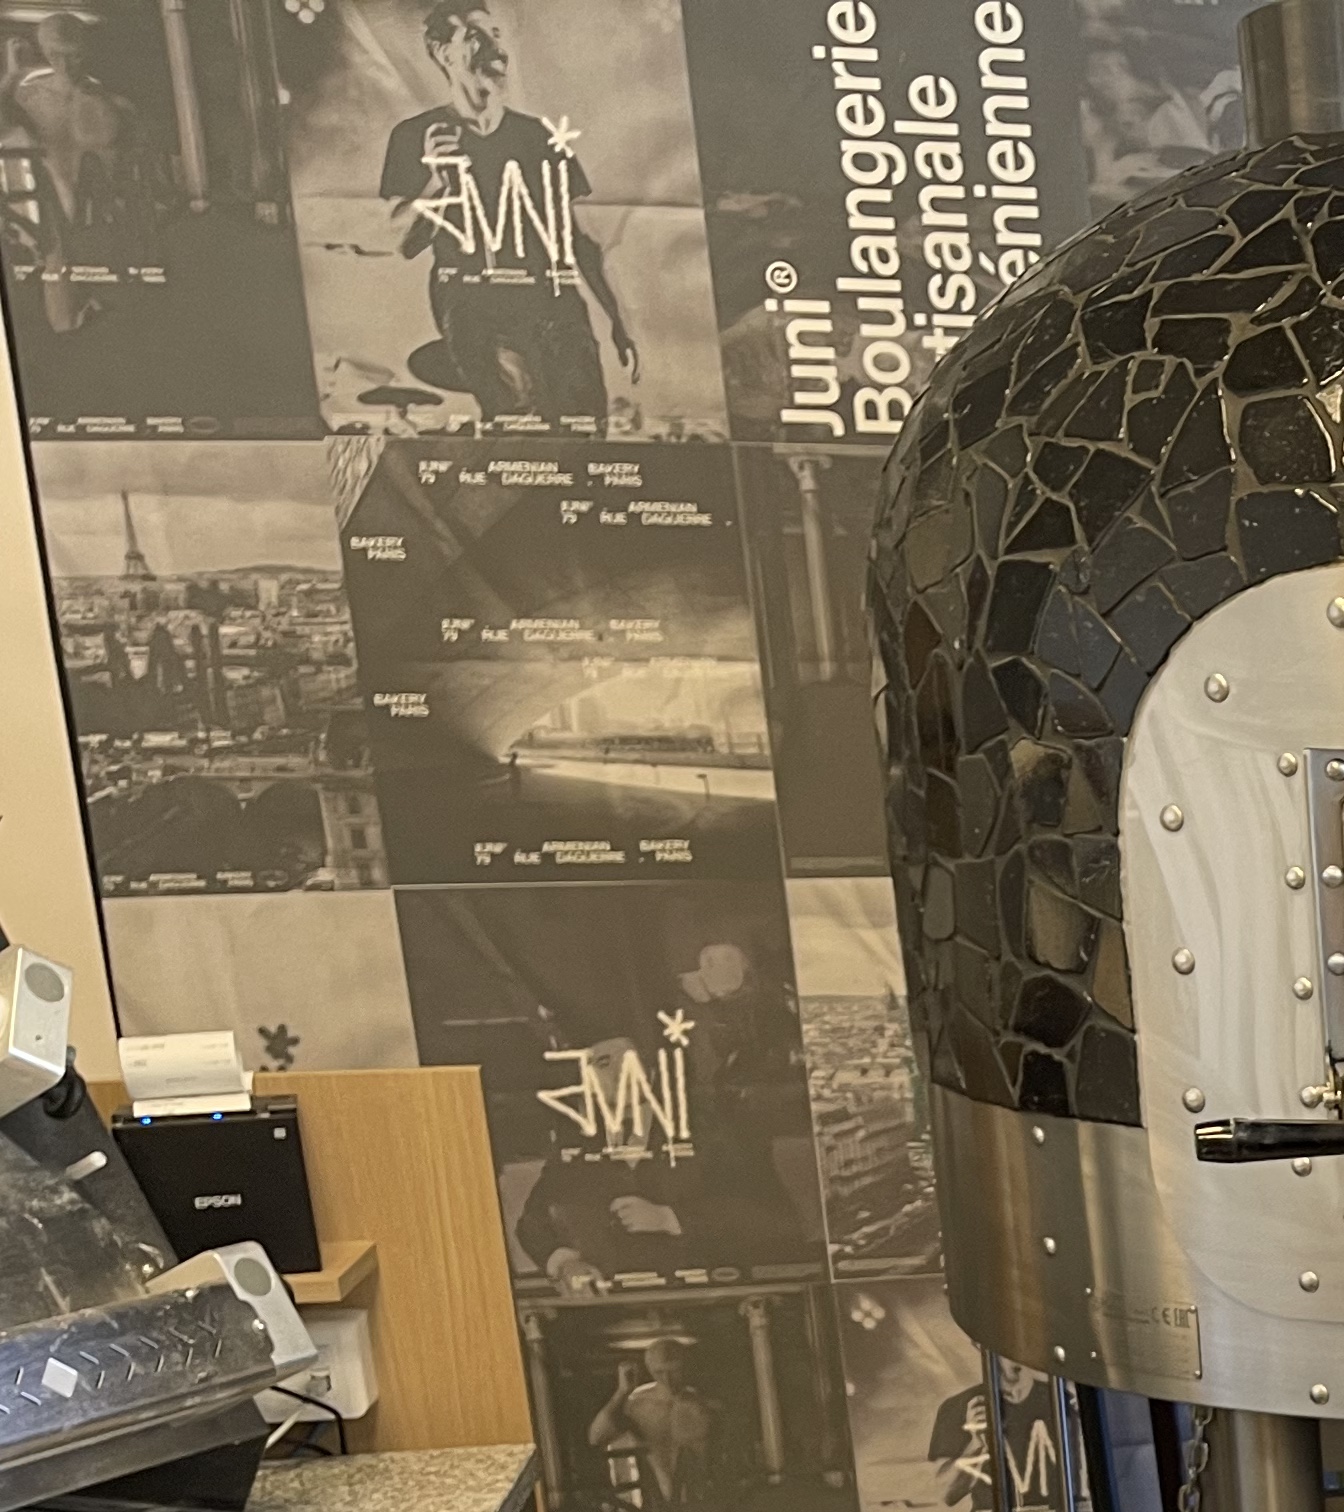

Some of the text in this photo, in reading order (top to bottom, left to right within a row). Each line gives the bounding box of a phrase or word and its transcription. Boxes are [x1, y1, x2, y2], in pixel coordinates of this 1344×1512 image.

[812, 0, 911, 435] Boulangerie
[894, 74, 978, 362] tisanale
[974, 0, 1042, 288] énienne
